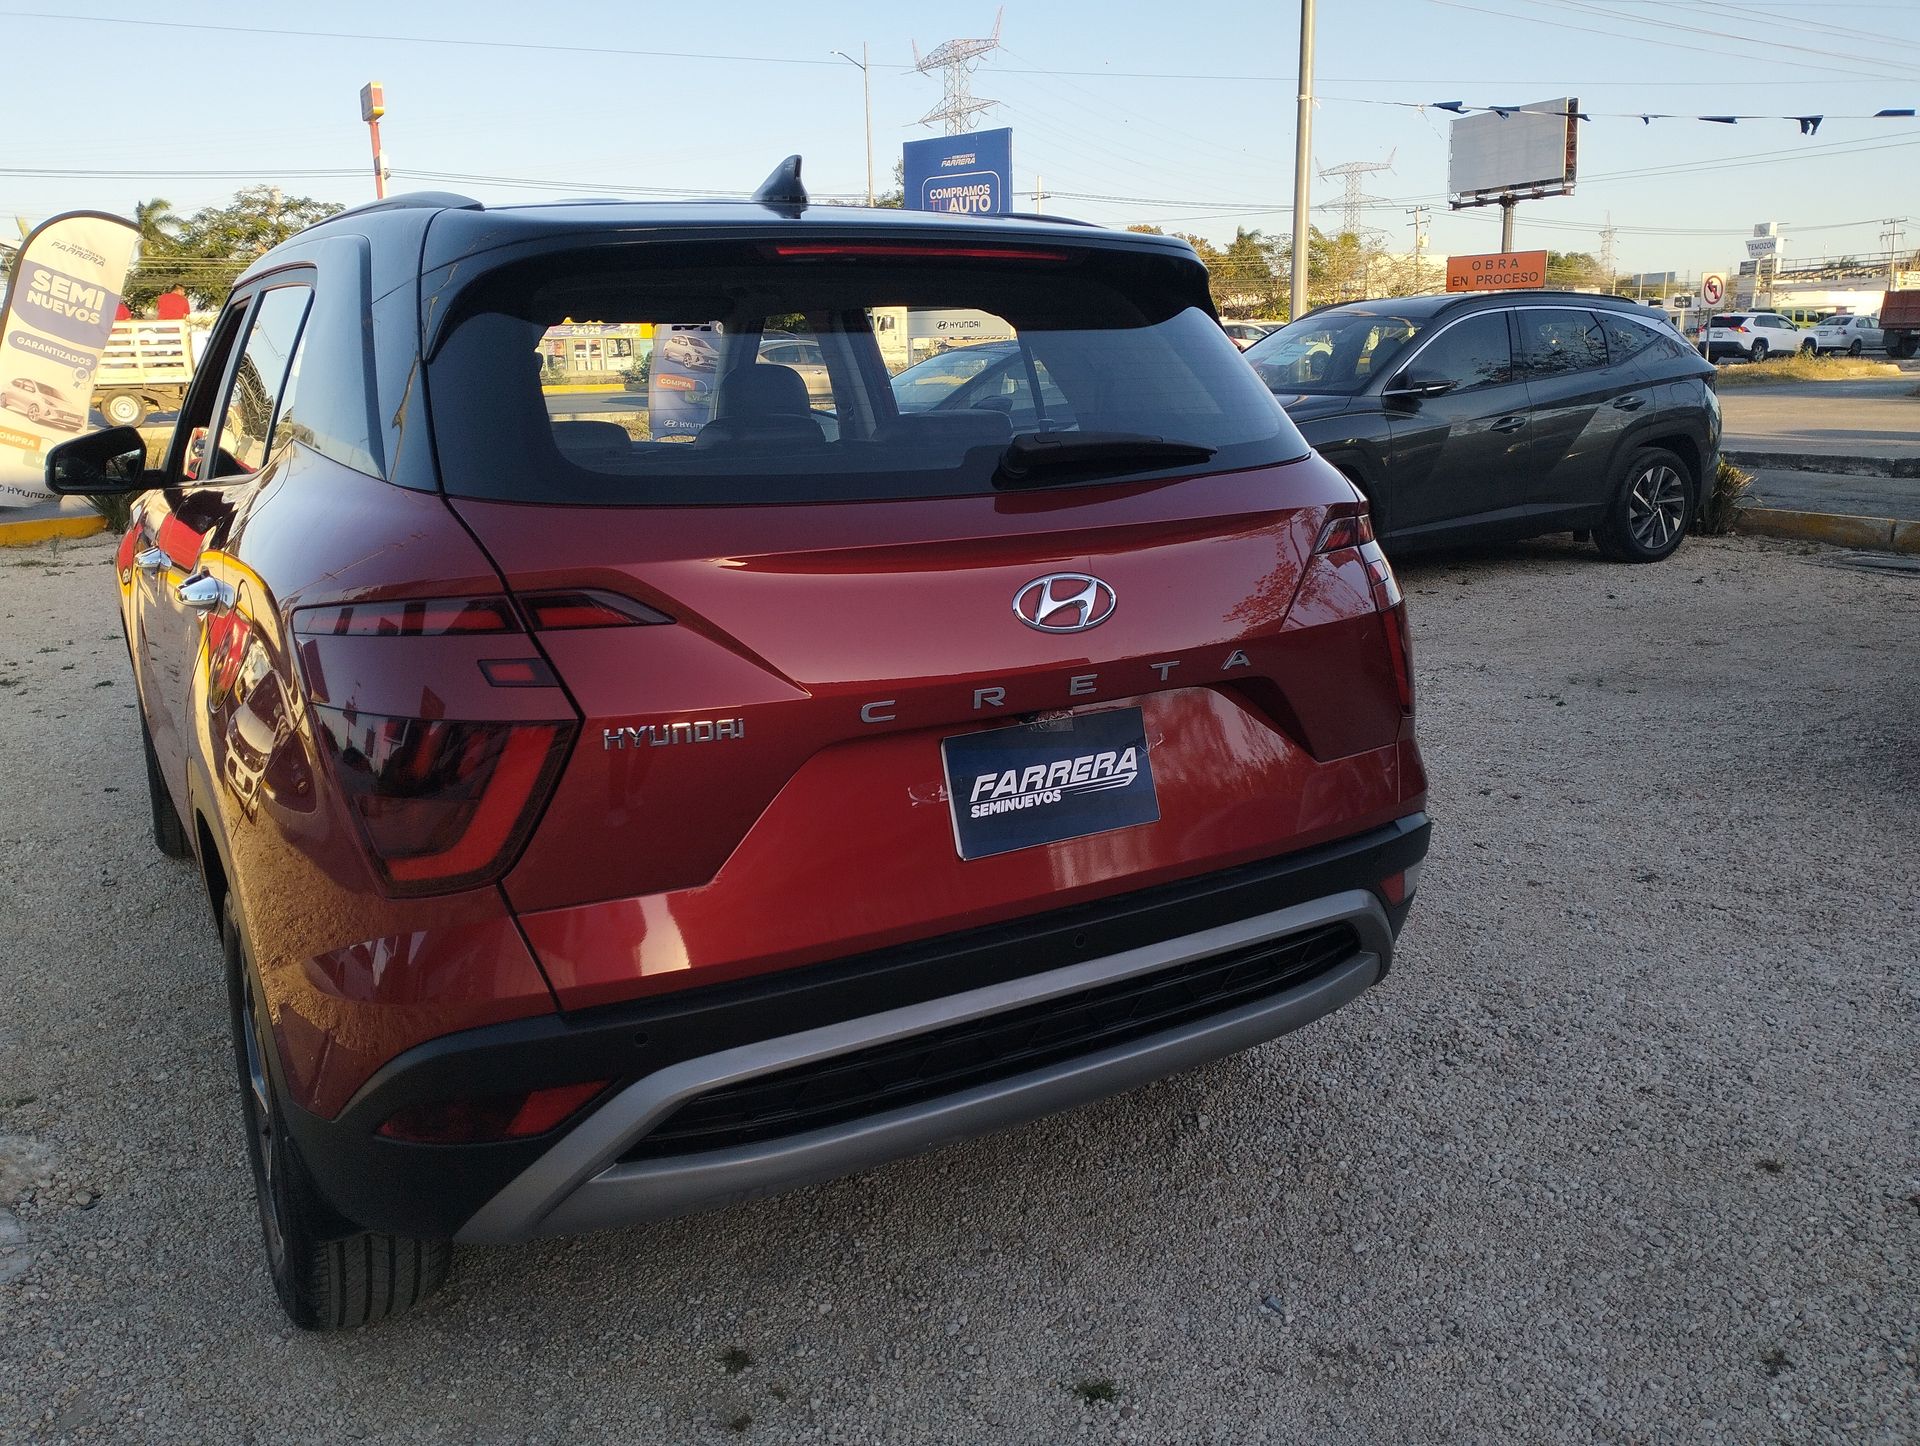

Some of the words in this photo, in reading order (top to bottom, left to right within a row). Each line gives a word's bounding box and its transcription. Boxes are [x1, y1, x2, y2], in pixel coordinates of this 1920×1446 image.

[929, 184, 991, 200] COMPRAMOS
[948, 195, 991, 213] AUTO
[51, 241, 105, 267] FARRERA
[1472, 258, 1519, 271] OBRA
[30, 269, 106, 311] SEMI
[1452, 276, 1469, 287] EN
[1476, 271, 1539, 285] PROCESO
[26, 289, 101, 325] NUEVOS
[949, 320, 981, 329] HYUNDAI
[16, 336, 92, 366] GARANTIZADOS
[660, 378, 692, 389] COMPRA
[679, 421, 706, 430] HYUN
[0, 431, 35, 447] OMPRA
[860, 649, 1252, 723] CRETA
[603, 718, 745, 750] HYUNDAI
[969, 747, 1138, 803] FARRERA
[970, 788, 1062, 819] SEMINUEVOS
